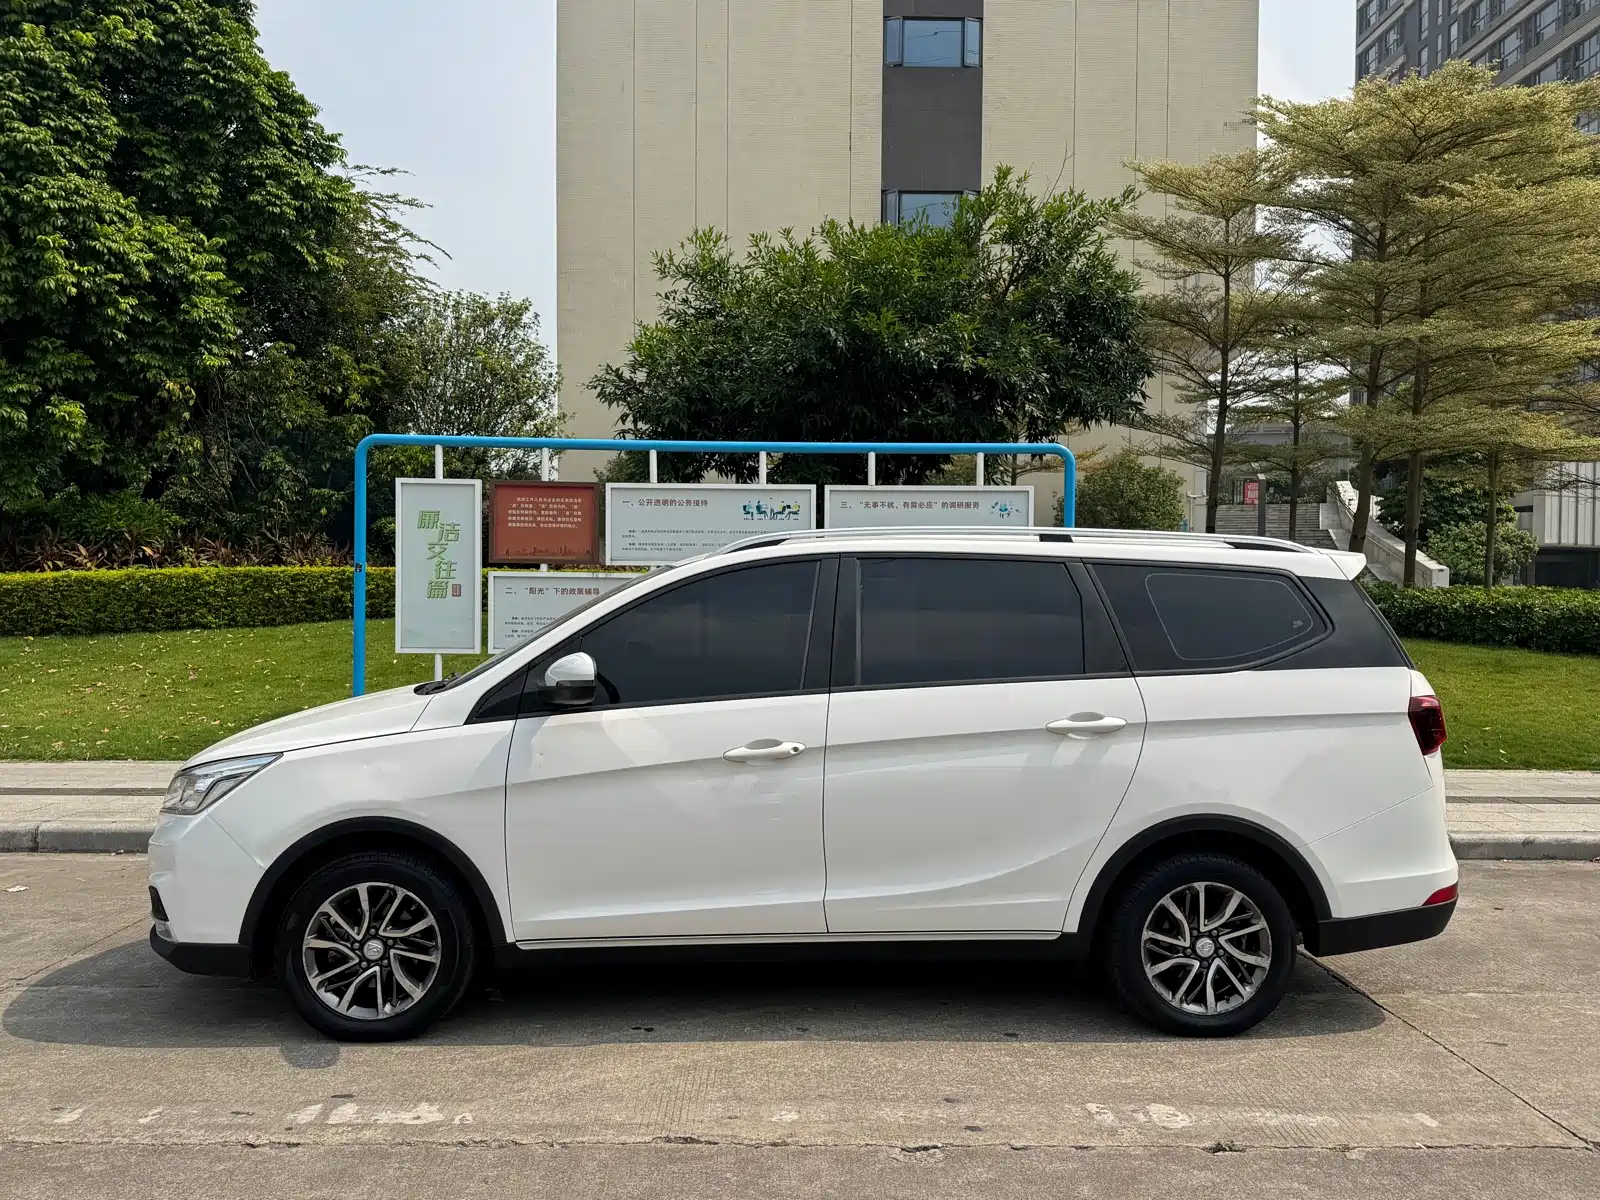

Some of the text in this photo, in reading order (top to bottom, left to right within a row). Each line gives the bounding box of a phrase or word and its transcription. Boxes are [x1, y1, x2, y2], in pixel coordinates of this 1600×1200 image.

[622, 498, 708, 507] 一、公开透明的公务接待
[417, 509, 461, 599] 廉洁交往篇
